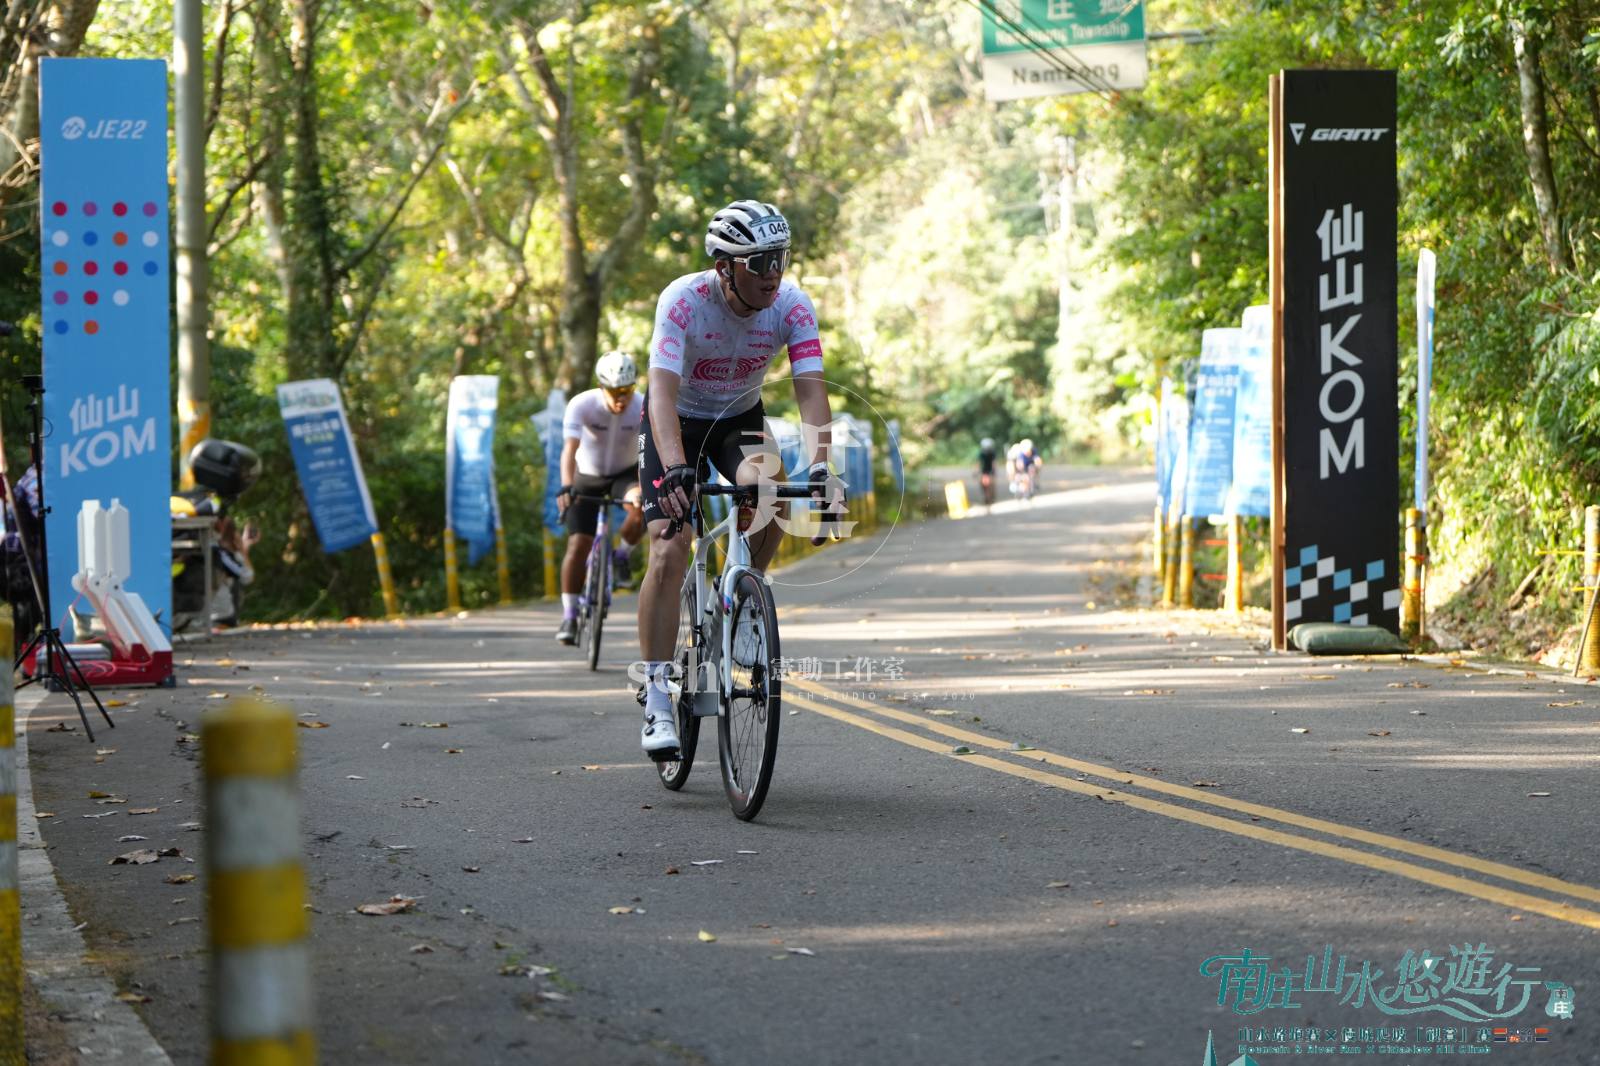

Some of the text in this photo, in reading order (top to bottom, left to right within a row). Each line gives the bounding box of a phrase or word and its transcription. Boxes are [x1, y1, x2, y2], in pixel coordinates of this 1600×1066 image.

[87, 119, 149, 140] JE22
[1310, 127, 1390, 142] GIANT
[69, 384, 139, 436] 仙山
[1318, 313, 1365, 480] KOM
[60, 417, 156, 477] KOM
